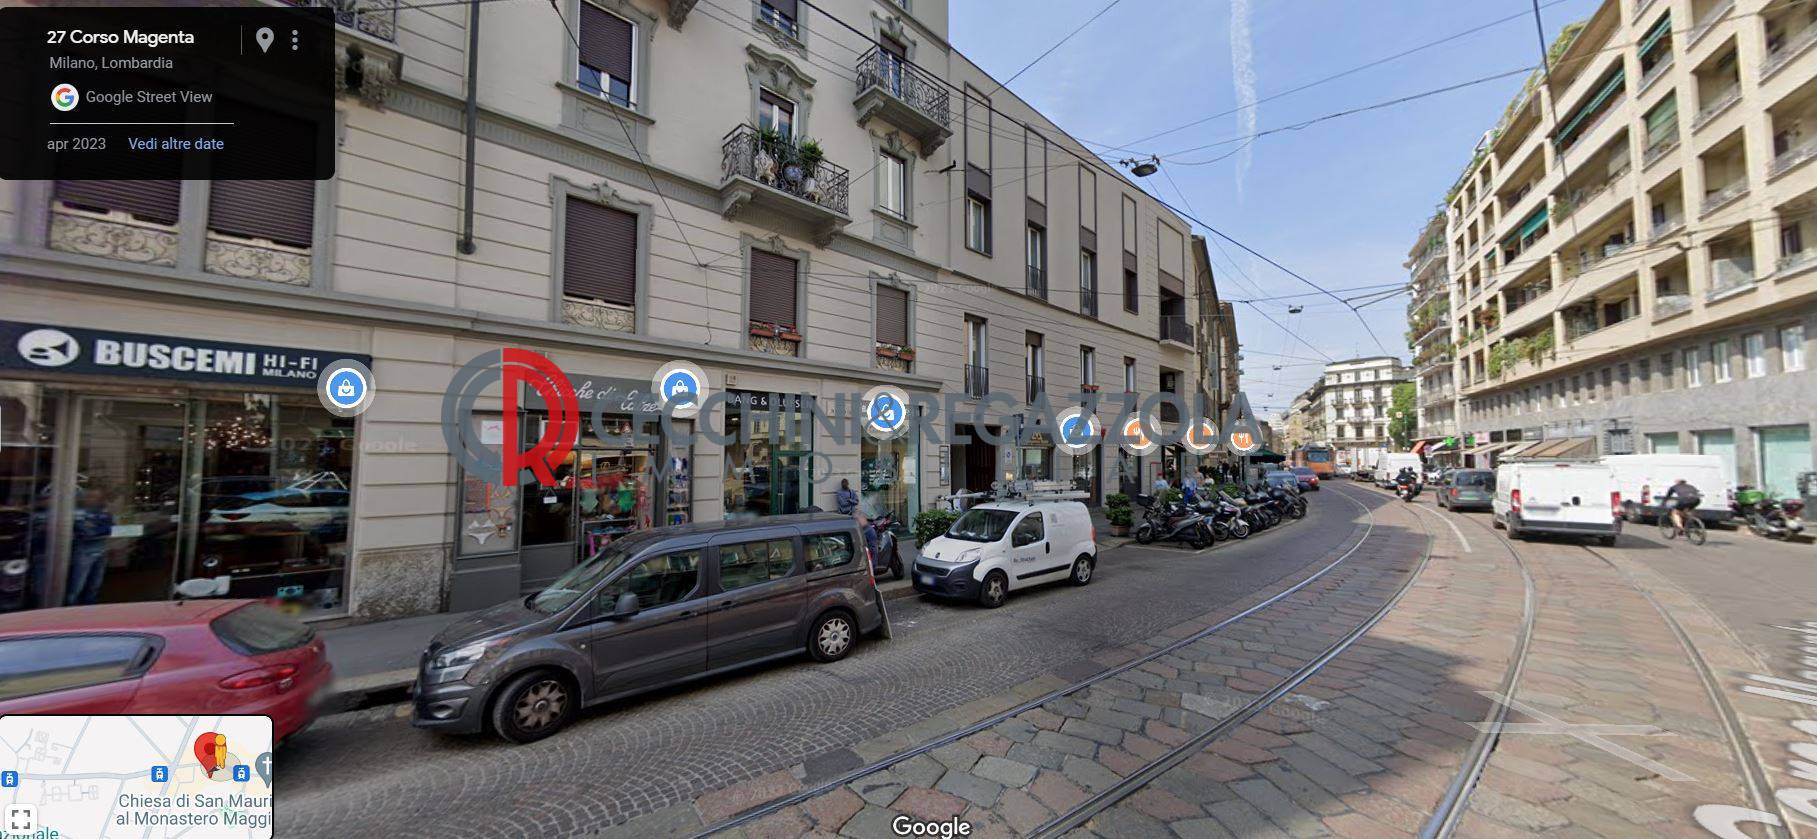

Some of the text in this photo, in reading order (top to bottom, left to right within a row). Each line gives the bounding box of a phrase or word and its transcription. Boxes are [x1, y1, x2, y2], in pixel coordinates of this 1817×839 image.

[96, 340, 318, 374] BUSCEMI HI-FI
[262, 368, 317, 379] MILANO
[760, 396, 768, 406] &
